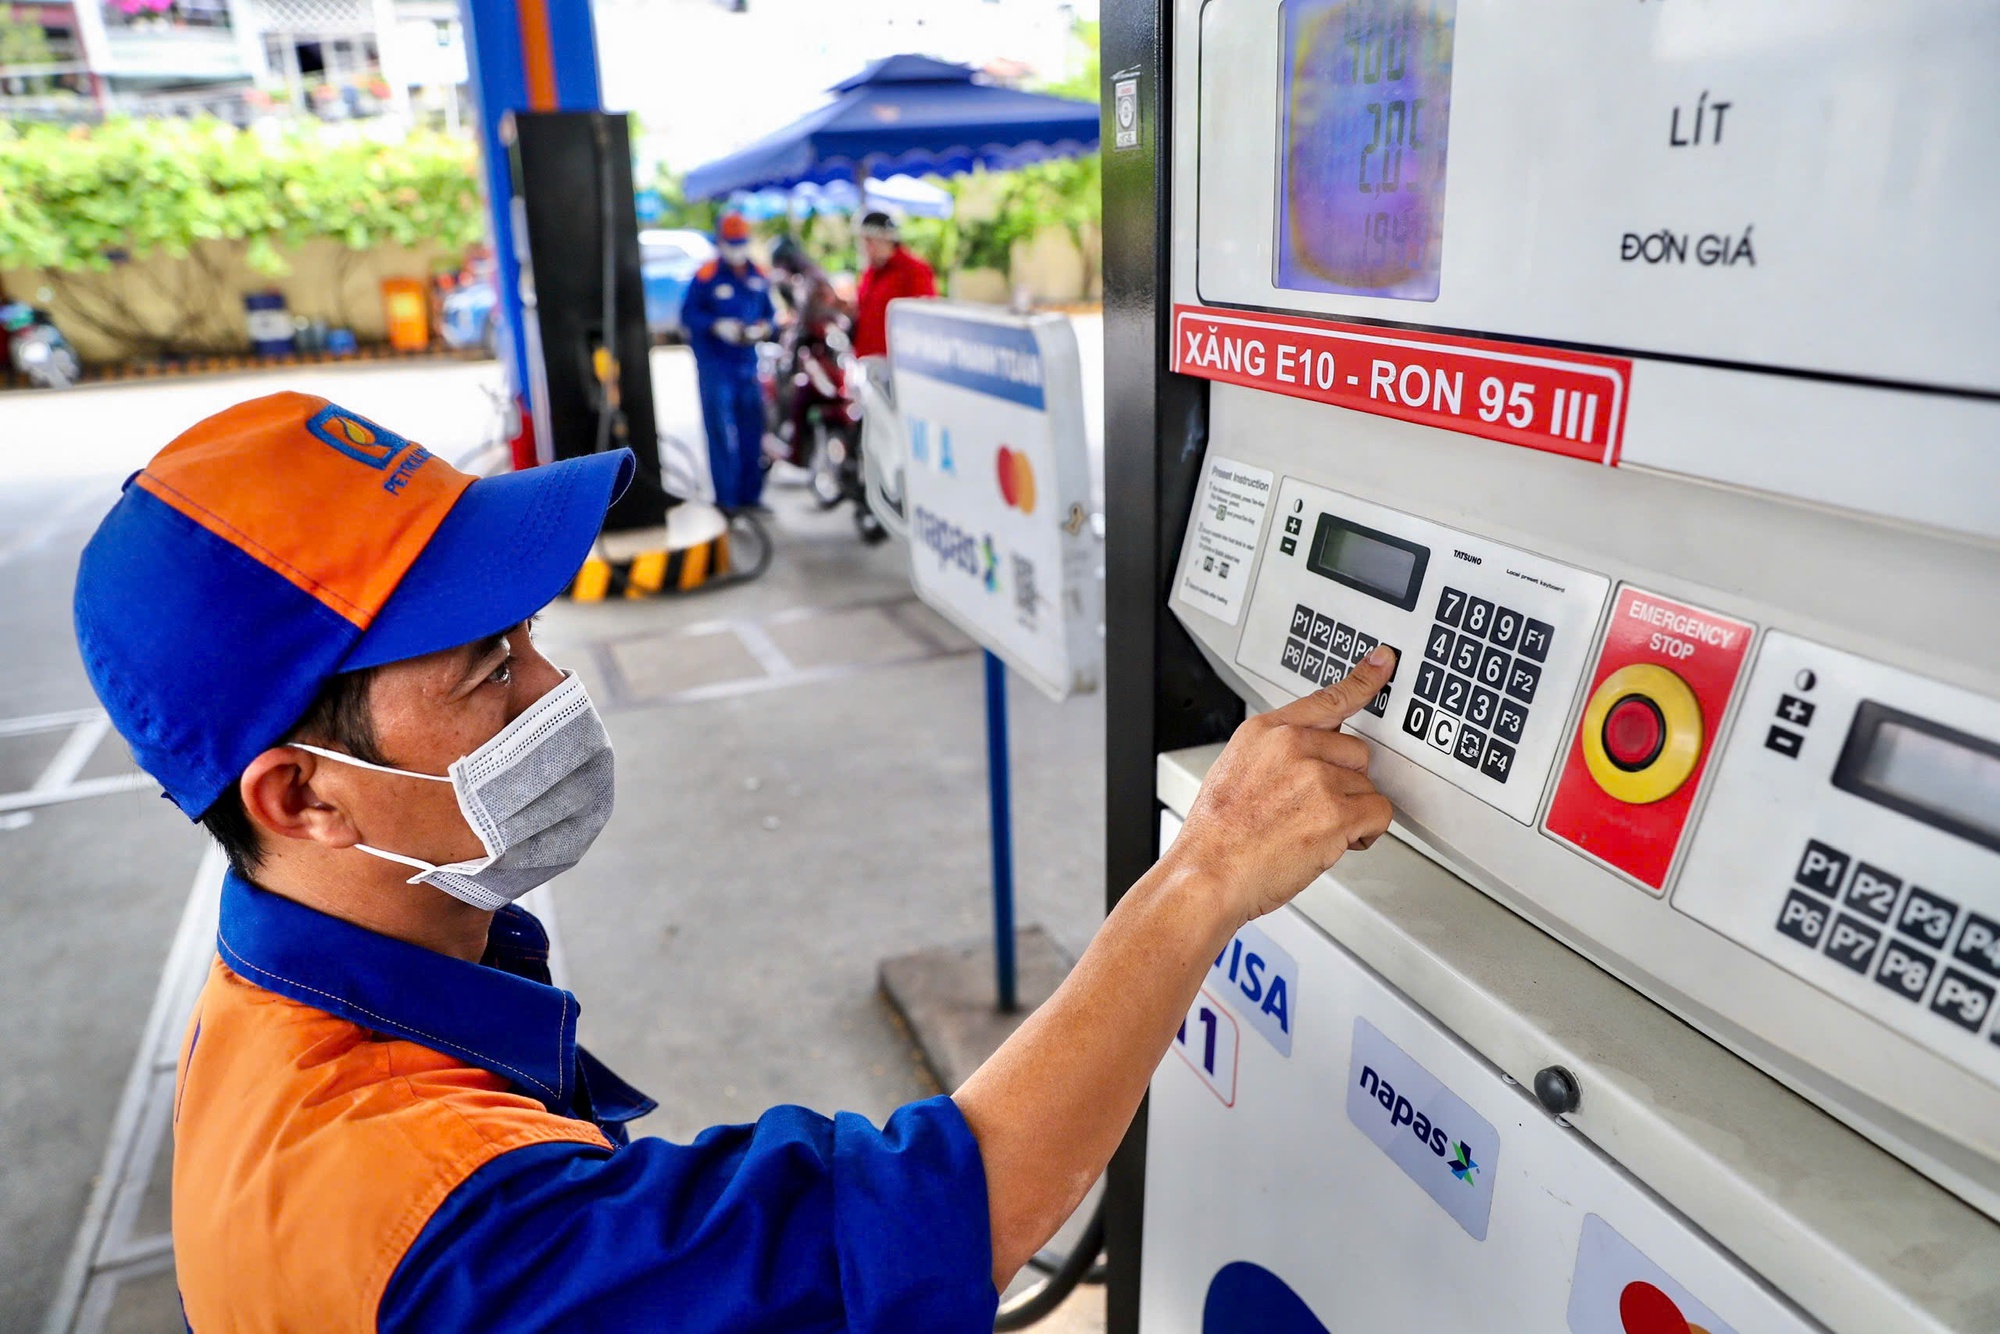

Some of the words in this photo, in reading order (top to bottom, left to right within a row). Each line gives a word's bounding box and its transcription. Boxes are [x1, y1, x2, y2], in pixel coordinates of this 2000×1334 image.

[1670, 90, 1731, 146] LÍT
[1621, 229, 1689, 264] ĐƠN
[1696, 223, 1756, 267] GIÁ
[1185, 325, 1266, 376] XĂNG
[1276, 344, 1335, 390] E10
[1347, 375, 1359, 385] -
[1369, 359, 1464, 415] RON
[1478, 376, 1536, 428] 95
[1550, 388, 1599, 443] III
[1233, 472, 1270, 492] Instruction
[1453, 549, 1482, 565] TATSUNO
[1506, 568, 1520, 577] Local
[1520, 574, 1539, 585] preset
[1539, 580, 1565, 593] keyboard
[1293, 611, 1309, 632] P1
[1313, 620, 1331, 642] P2
[1333, 630, 1352, 652] P3
[1444, 593, 1460, 618] 7
[1470, 604, 1486, 630] 8
[1497, 615, 1515, 641] 9
[1524, 629, 1545, 651] F1
[1628, 599, 1735, 649] EMERGENCY
[1649, 632, 1696, 660] STOP
[1284, 644, 1301, 665] P6
[1303, 654, 1322, 675] P7
[1324, 664, 1342, 684] P8
[1432, 633, 1447, 658] 4
[1458, 643, 1475, 670] 5
[1485, 655, 1502, 682] 6
[1512, 669, 1534, 693] F2
[1374, 692, 1388, 711] 10
[1424, 670, 1435, 695] 1
[1445, 682, 1463, 709] 2
[1473, 694, 1490, 721] 3
[1499, 709, 1521, 733] F3
[1409, 707, 1425, 733] 0
[1435, 720, 1453, 746] C
[1487, 749, 1509, 773] F4
[1802, 850, 1842, 888] P1
[1850, 872, 1896, 914] P2
[1902, 896, 1951, 940] P3
[1782, 899, 1823, 938] P6
[1829, 922, 1875, 961] P7
[1879, 948, 1929, 992] P8
[1935, 975, 1988, 1023] P9
[1176, 1007, 1217, 1076] 1
[1359, 1065, 1448, 1157] napas
